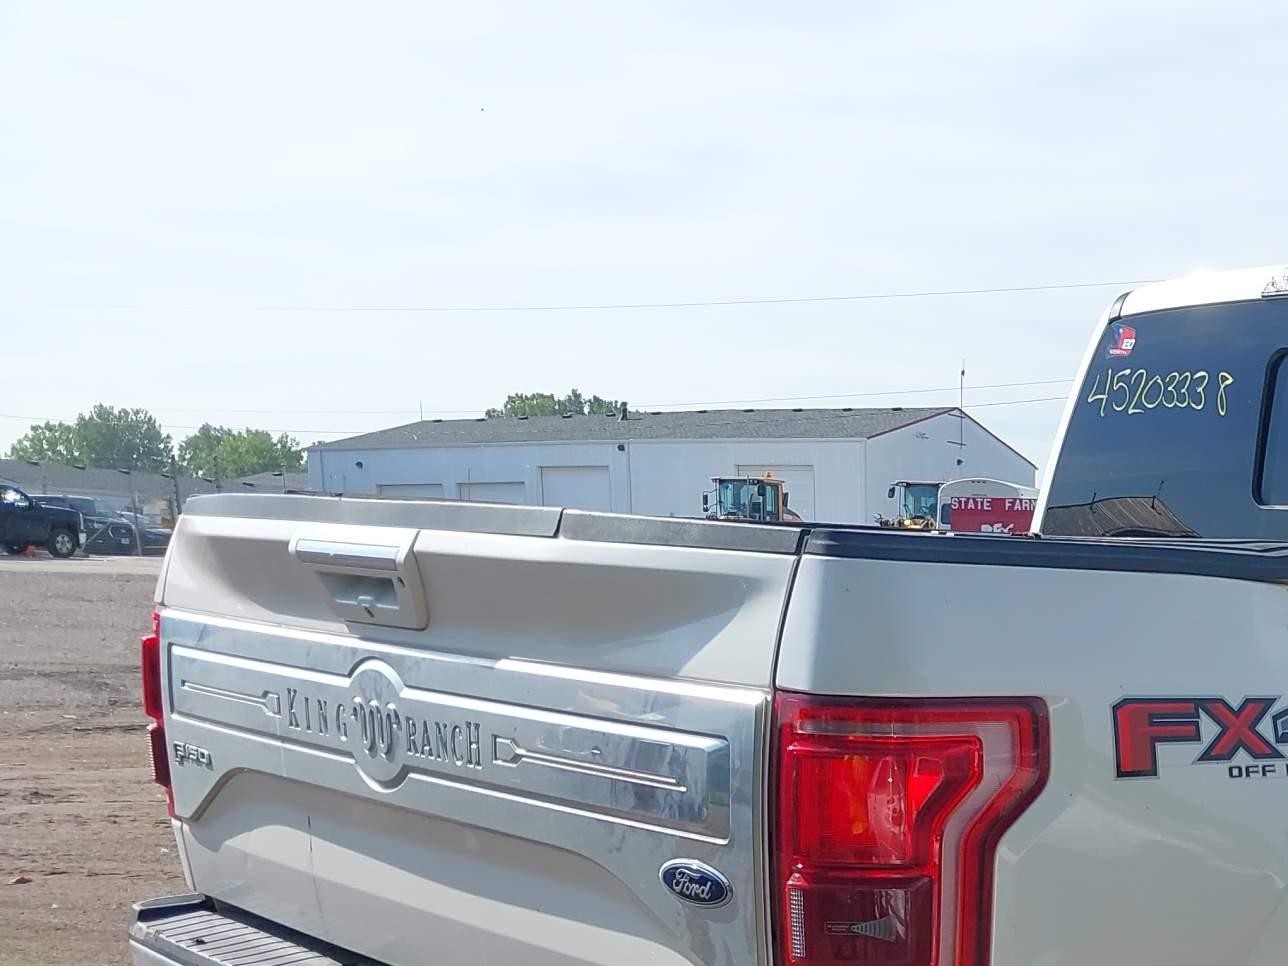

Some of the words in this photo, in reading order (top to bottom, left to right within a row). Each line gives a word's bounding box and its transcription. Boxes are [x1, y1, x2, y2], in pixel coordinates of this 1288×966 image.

[1087, 367, 1234, 417] 45203338
[951, 497, 992, 511] STATE
[286, 687, 350, 743] KING
[404, 715, 483, 770] RANCH
[1228, 764, 1276, 778] OFF
